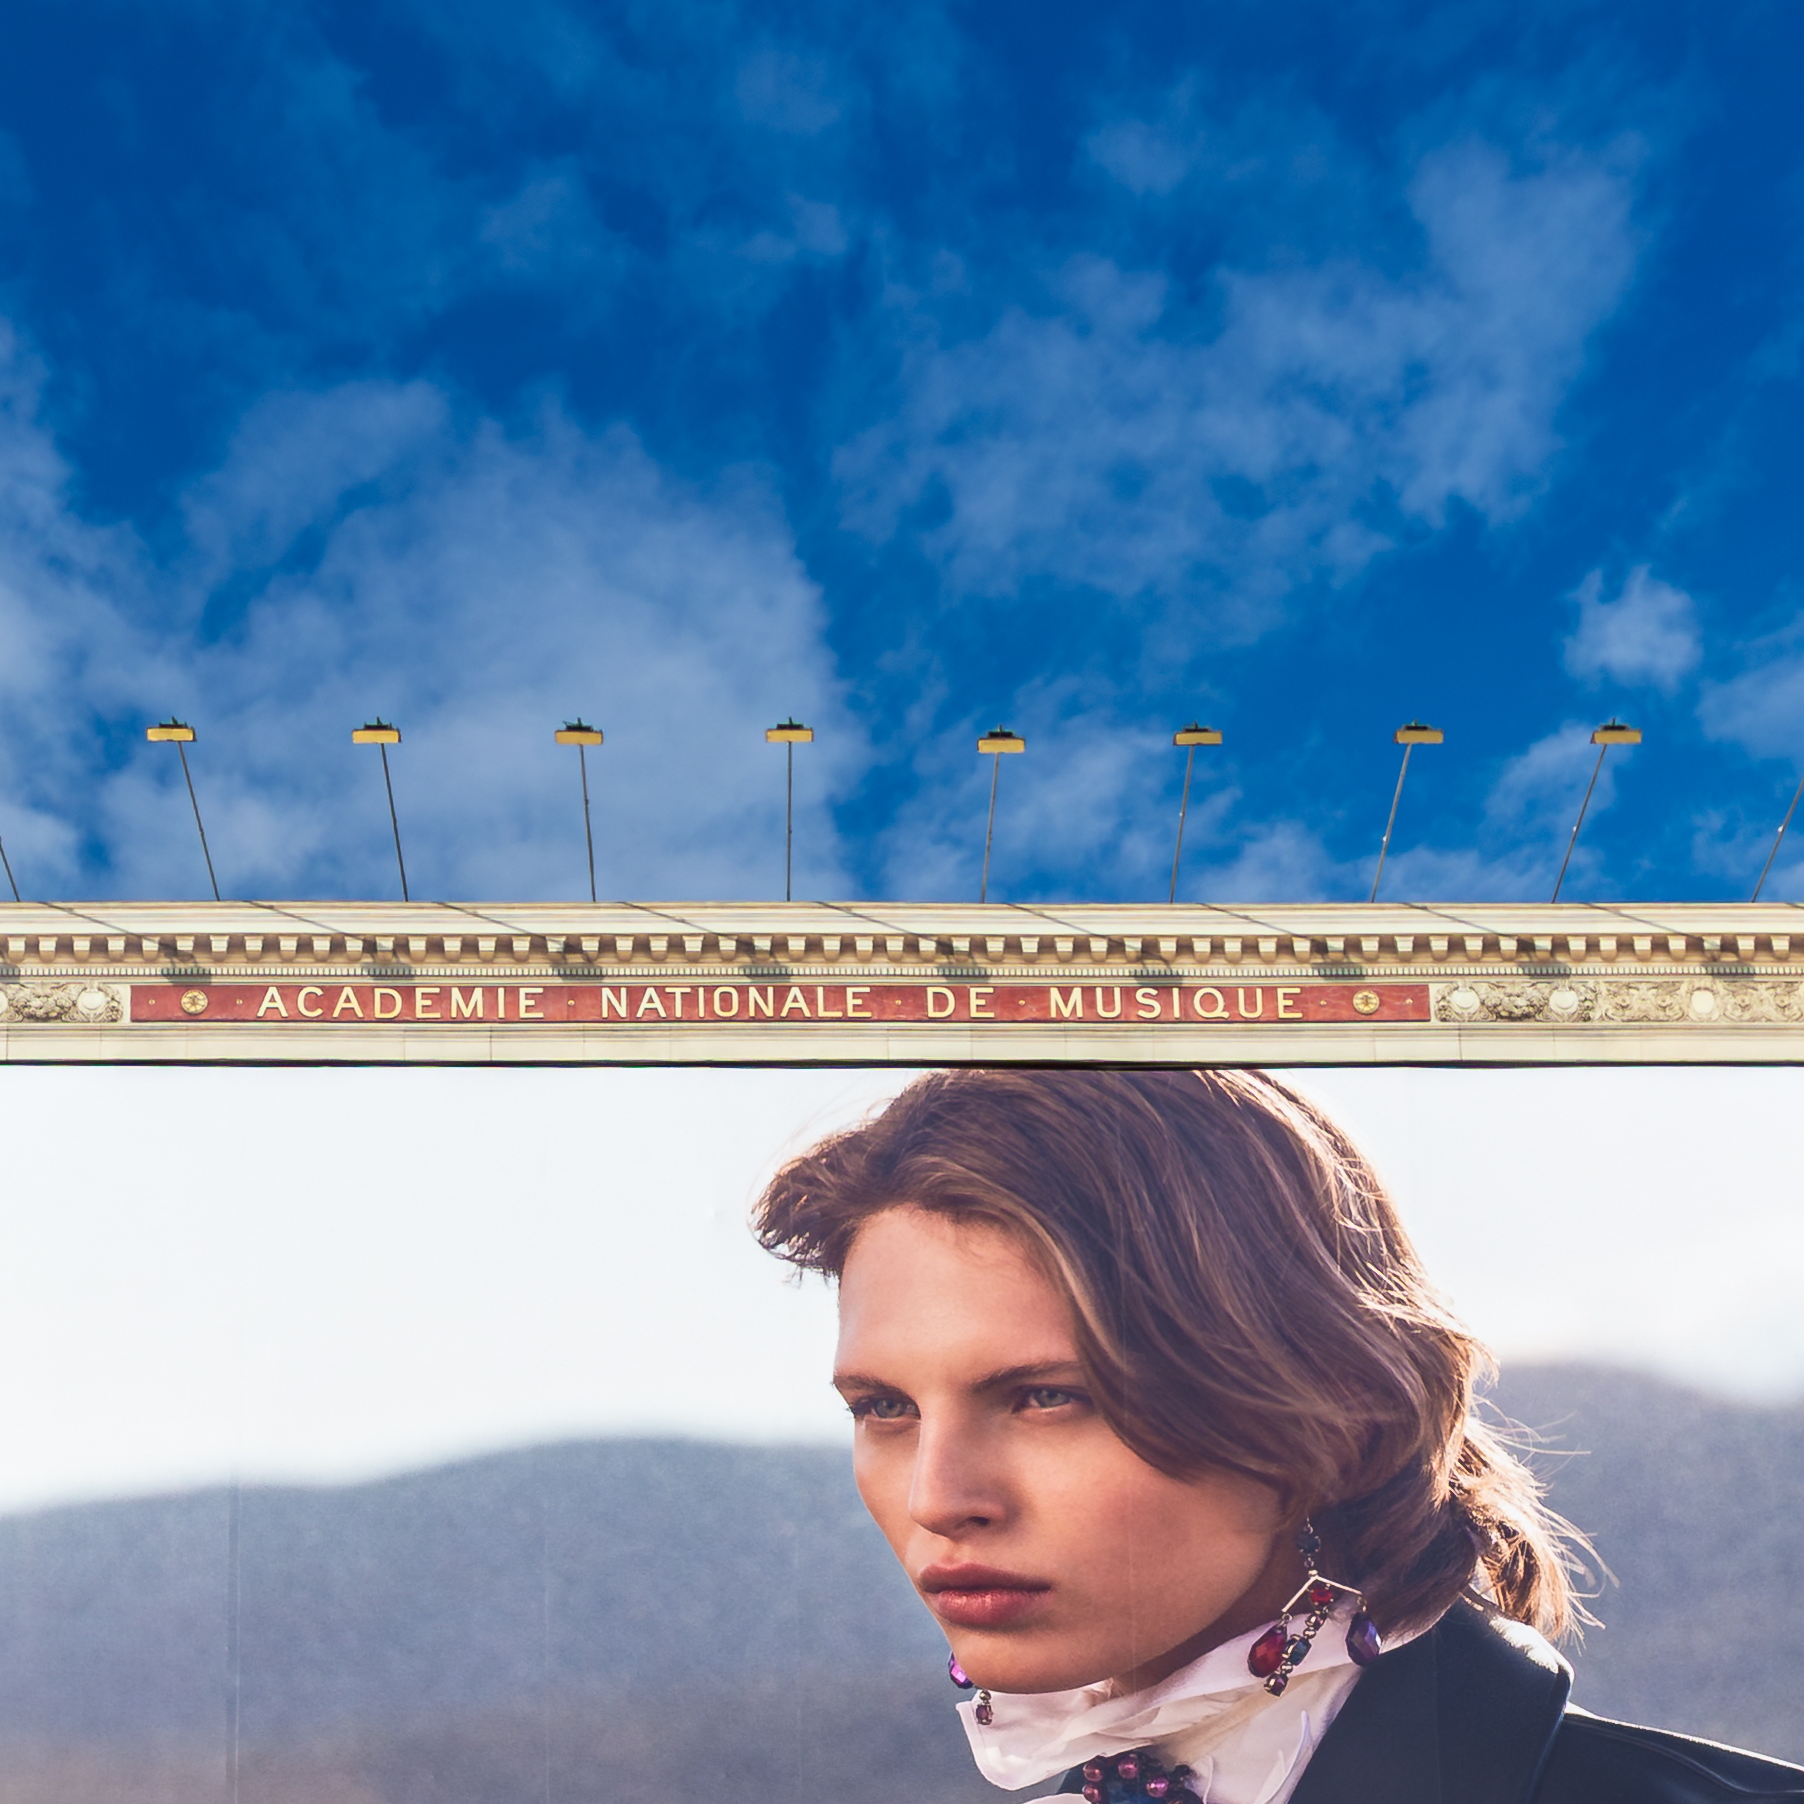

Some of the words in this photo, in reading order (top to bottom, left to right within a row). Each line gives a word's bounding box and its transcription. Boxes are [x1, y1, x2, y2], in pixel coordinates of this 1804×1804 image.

[256, 986, 545, 1018] ACADEMIE
[601, 986, 872, 1018] NATIONALE
[926, 986, 995, 1018] DE
[1049, 986, 1303, 1020] MUSIQUE
